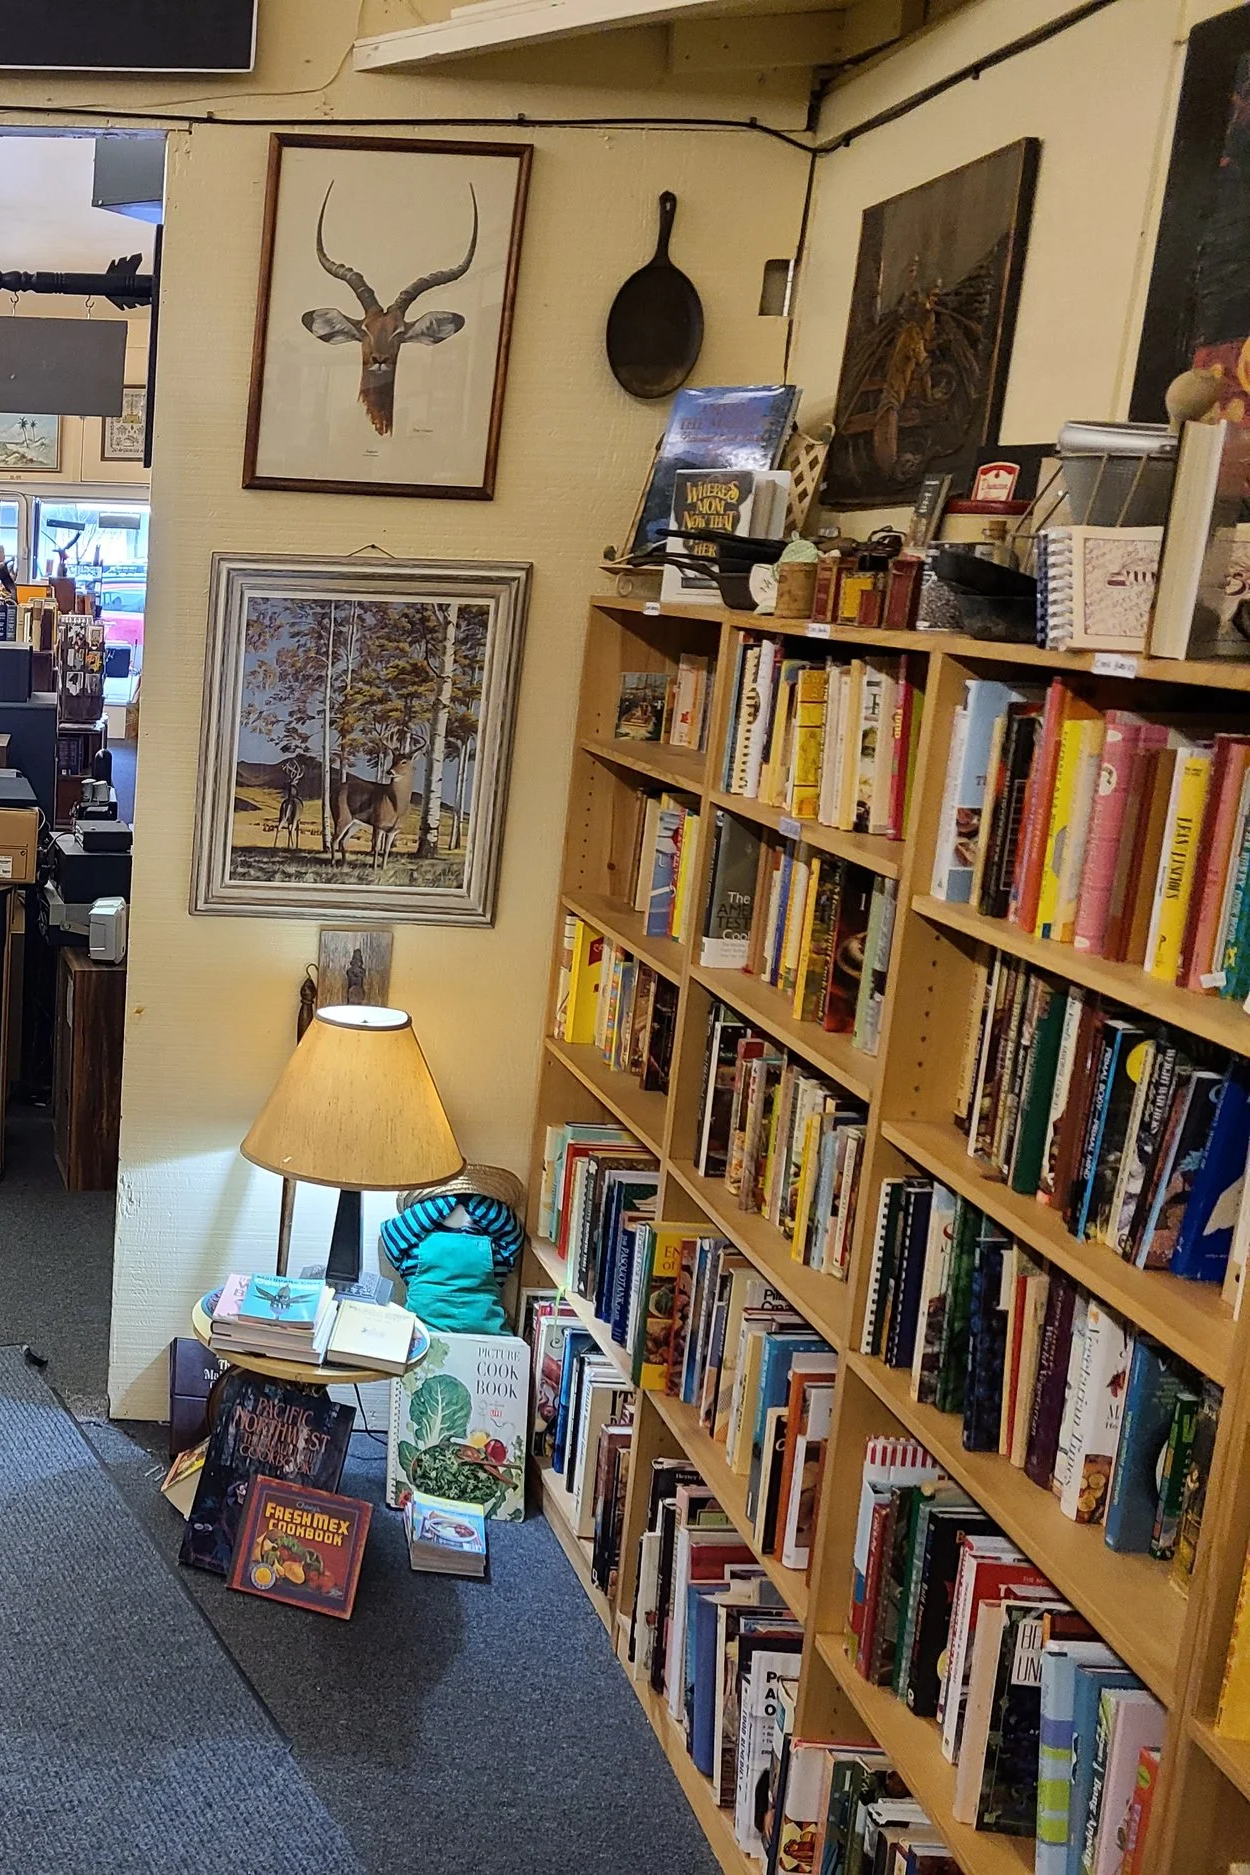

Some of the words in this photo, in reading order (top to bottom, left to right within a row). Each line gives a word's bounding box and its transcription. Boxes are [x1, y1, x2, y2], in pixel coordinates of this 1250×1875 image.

[1174, 815, 1194, 850] LEAN
[1166, 850, 1188, 900] LUSCIOUS
[728, 892, 750, 904] The
[1100, 1046, 1113, 1082] PRIMAL
[1158, 1049, 1178, 1086] WEIGHT
[1150, 1084, 1170, 1135] WATCHERS
[1082, 1150, 1094, 1180] MIND
[615, 1246, 628, 1304] PASQUOTANK
[662, 1261, 676, 1270] of
[478, 1346, 520, 1362] PICTURE
[1040, 1324, 1053, 1366] World
[476, 1362, 519, 1381] COOK
[1073, 1326, 1101, 1427] Vegetarian
[476, 1380, 518, 1400] BOOK
[1031, 1369, 1047, 1436] Vegetarian
[233, 1405, 330, 1452] NORTHWEST
[256, 1397, 314, 1429] PACIFIC
[240, 1444, 310, 1475] COOKBOOK
[1062, 1432, 1084, 1487] Times
[268, 1518, 344, 1546] COOKBOOK
[1087, 1776, 1102, 1814] Bong
